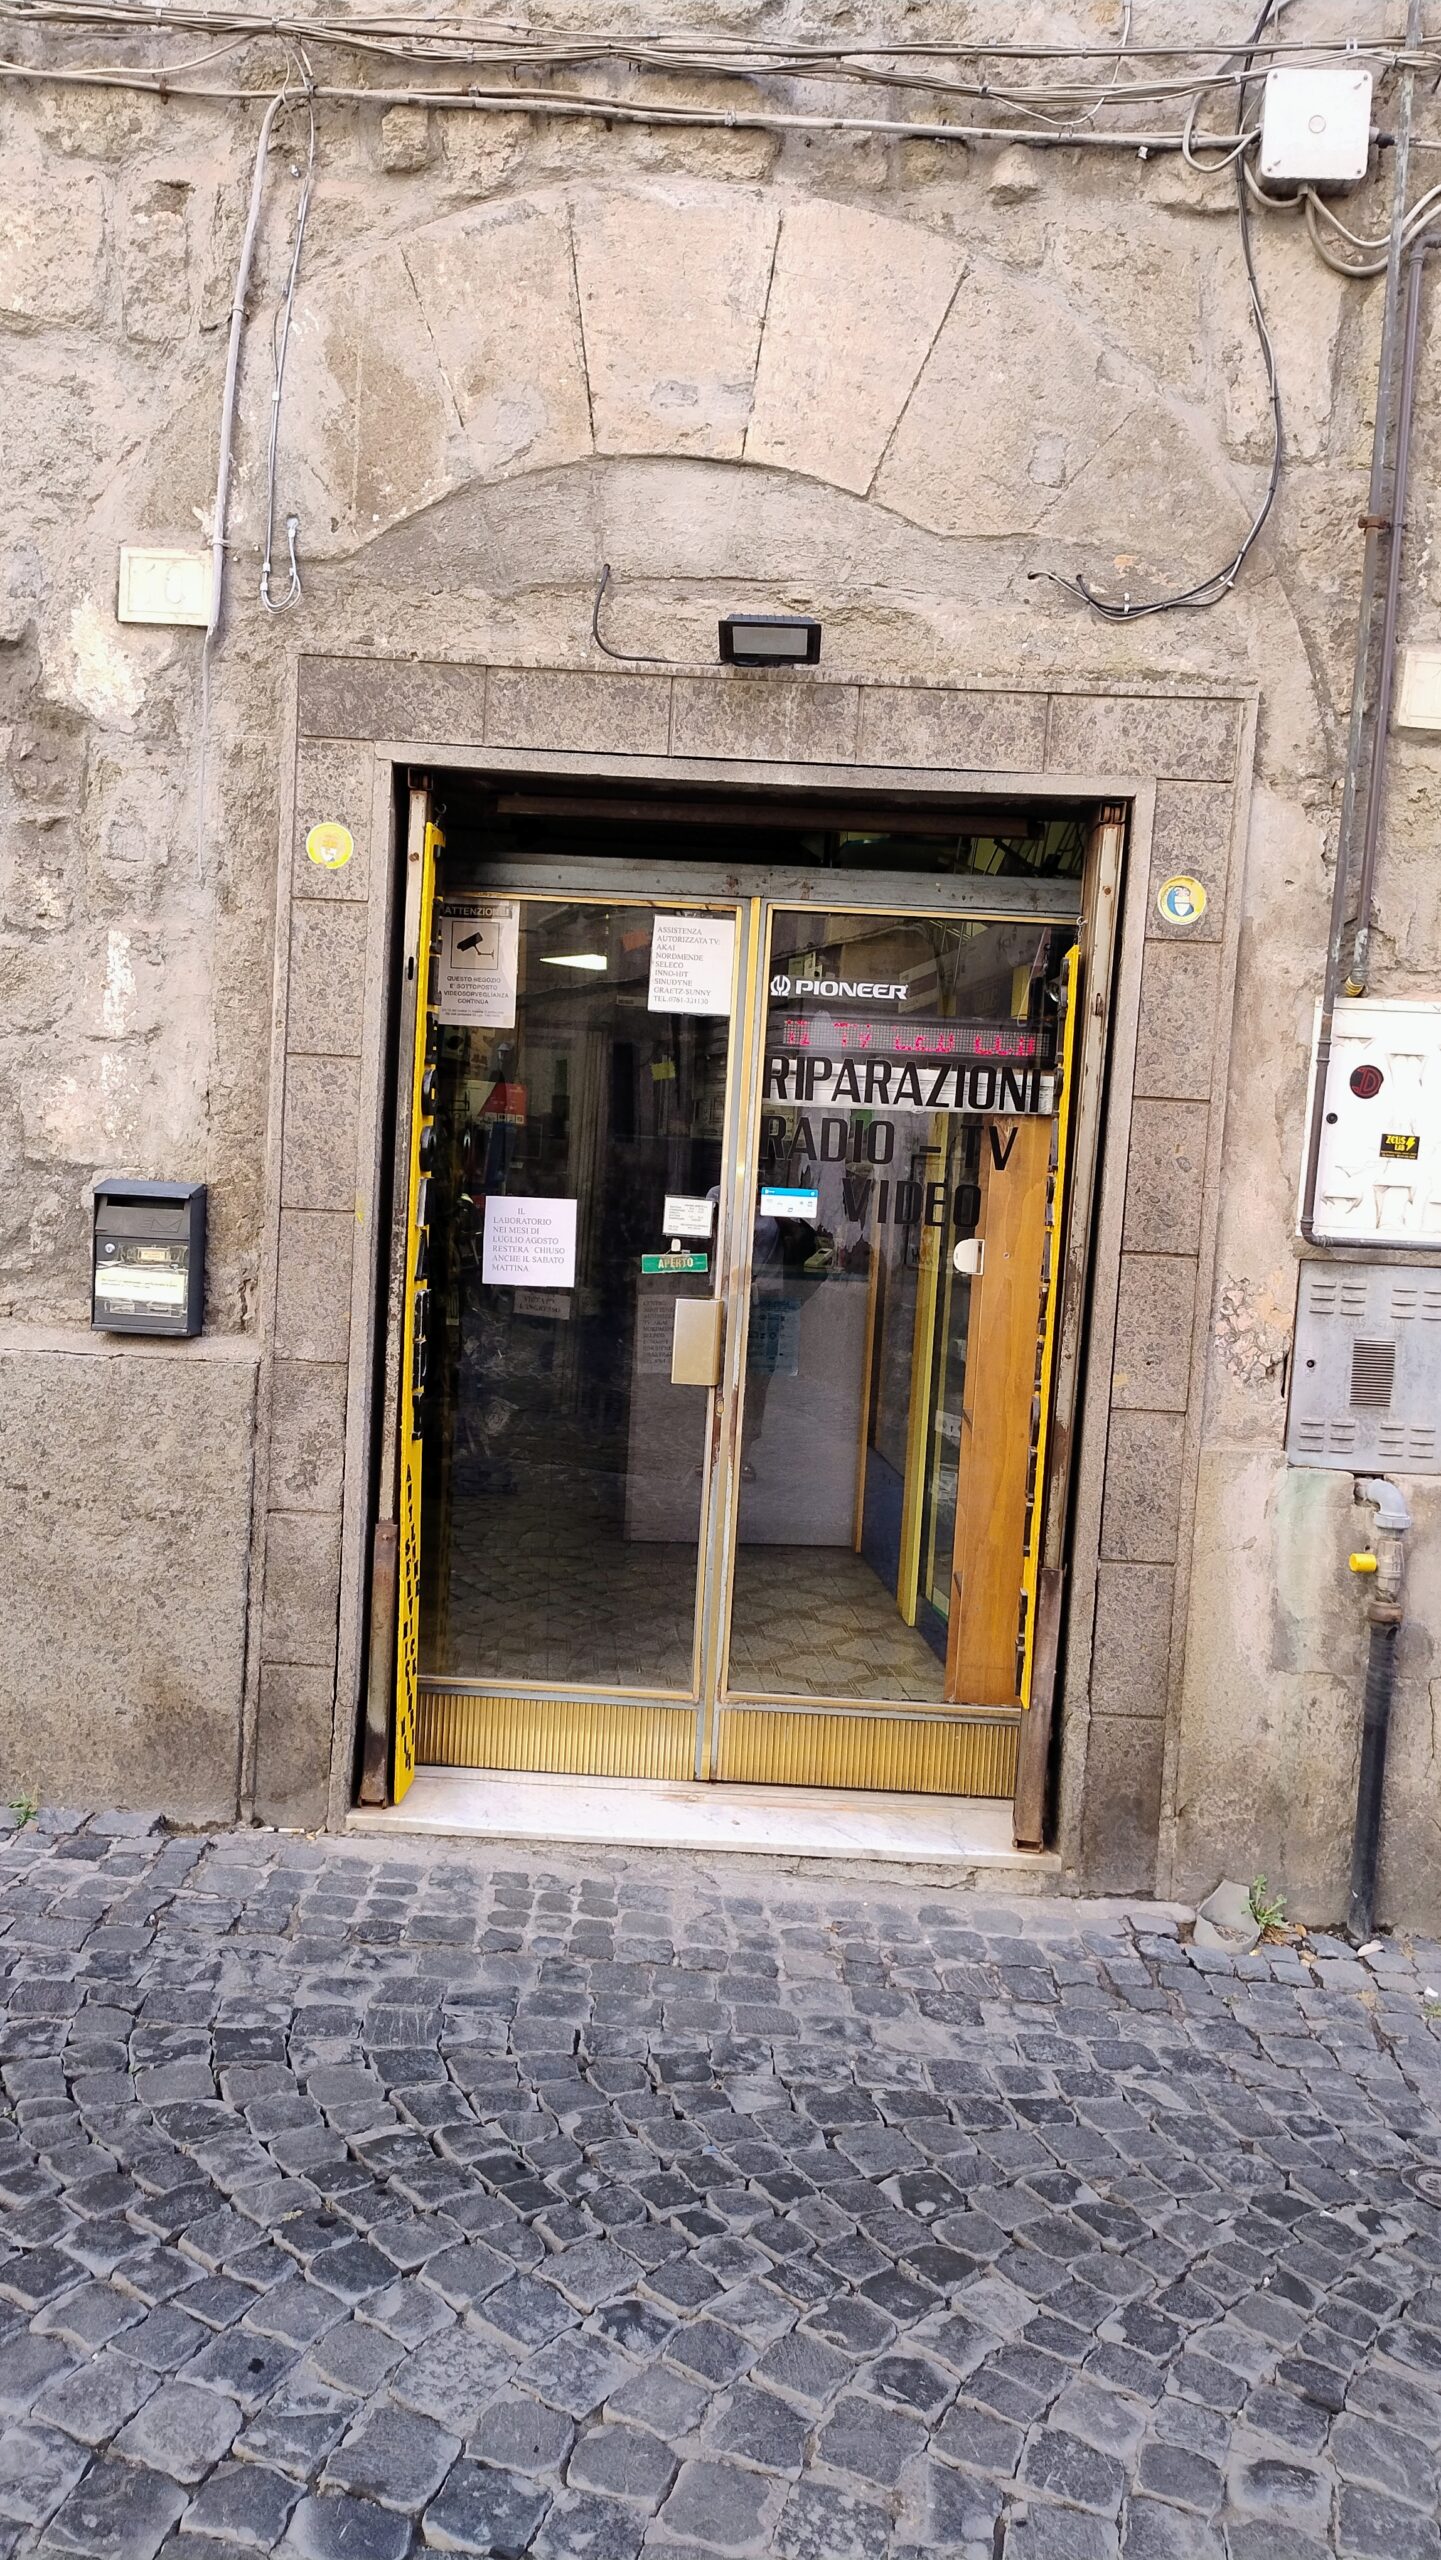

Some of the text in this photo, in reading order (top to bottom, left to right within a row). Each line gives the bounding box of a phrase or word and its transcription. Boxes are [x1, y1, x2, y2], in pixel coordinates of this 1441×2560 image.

[658, 927, 702, 935] ASSISTENZA
[656, 936, 708, 944] AUTORIZZATA
[655, 953, 704, 961] NORDMENDE
[655, 961, 684, 969] SELECO
[655, 970, 688, 978] INNO-HIT
[654, 978, 693, 986] SINUDYNE
[795, 980, 908, 1000] PIONEER
[443, 991, 509, 999] VIDEOSORVEGLIANZA
[763, 1054, 1041, 1113] RIPARAZIONI
[758, 1115, 895, 1165] RADIO
[960, 1123, 1019, 1171] TV
[1385, 1135, 1407, 1145] ZEUS
[842, 1177, 982, 1228] VIDEO
[493, 1217, 552, 1225] LABORATORIO
[493, 1226, 507, 1234] NEI
[509, 1227, 529, 1235] MESI
[492, 1236, 559, 1245] LUGLIO AGOSTO
[534, 1247, 566, 1255] CHIUSO
[493, 1255, 521, 1263] ANCHE
[532, 1256, 565, 1264] SABATO
[658, 1257, 694, 1269] APERTO
[492, 1264, 529, 1272] MATTINA
